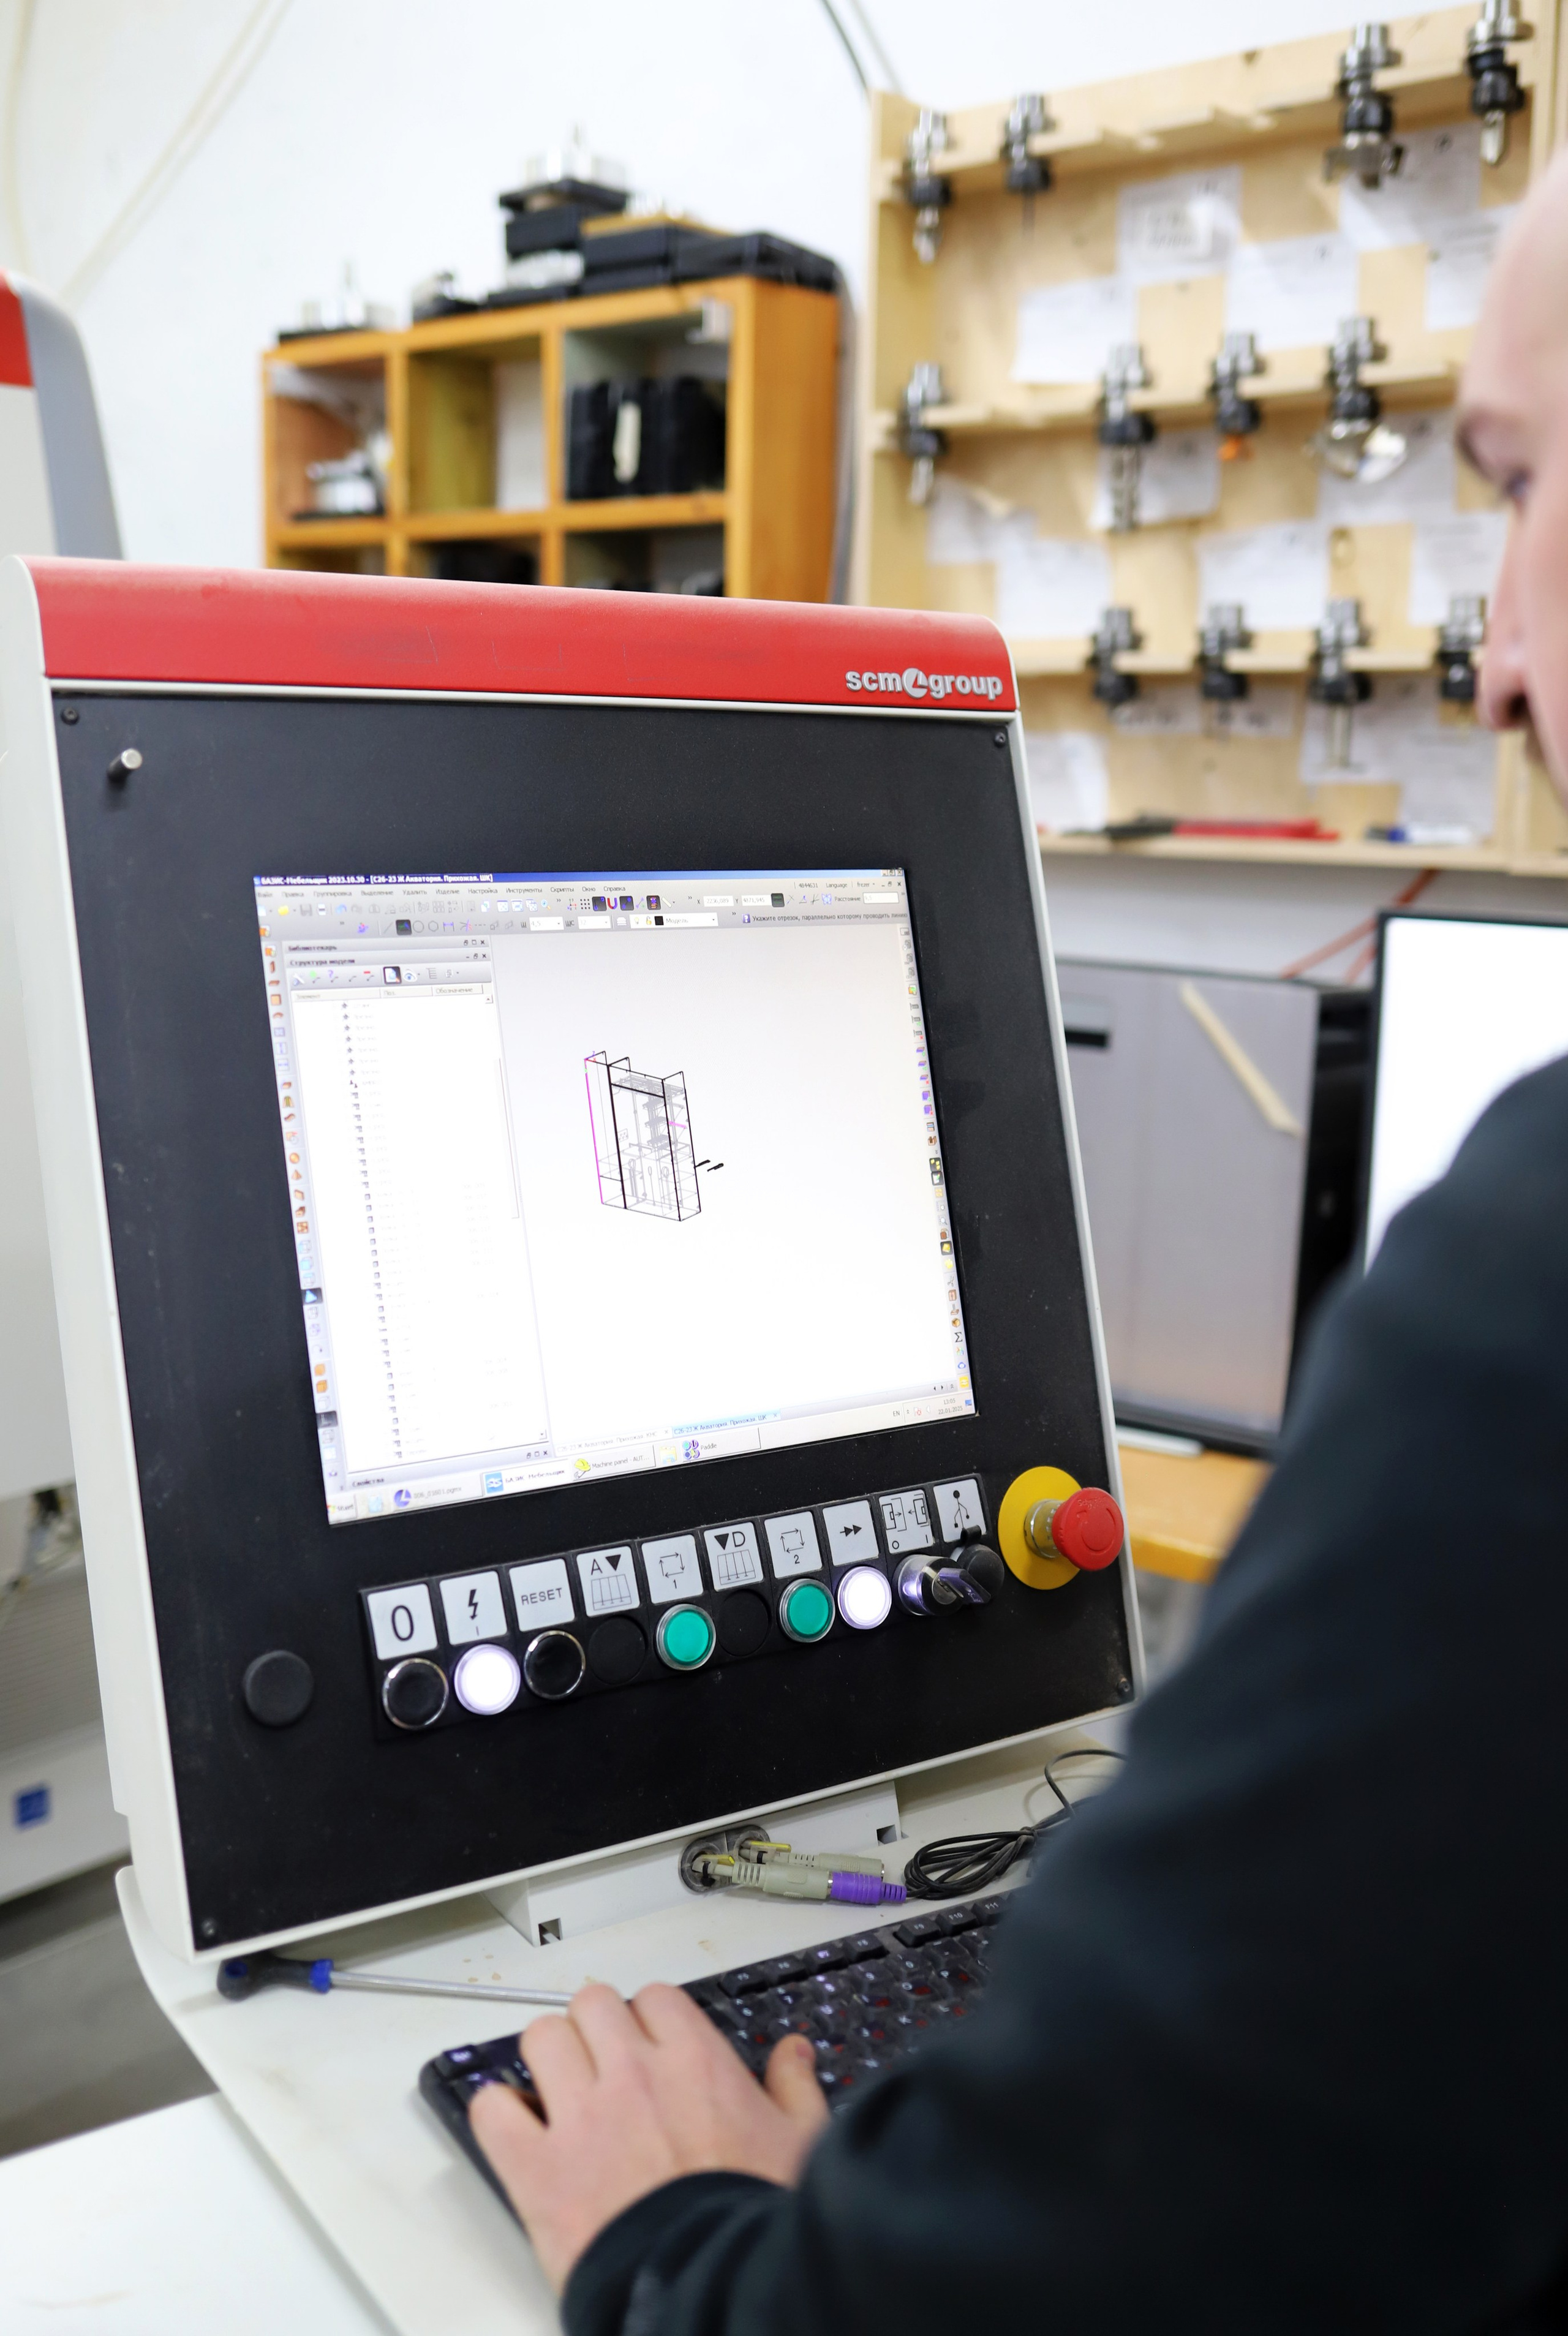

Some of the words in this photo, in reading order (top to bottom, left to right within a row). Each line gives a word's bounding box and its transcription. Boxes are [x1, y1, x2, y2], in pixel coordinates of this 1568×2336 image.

[845, 670, 903, 692] scm
[928, 674, 1003, 701] group
[938, 1406, 963, 1415] 22.01.2025
[592, 1460, 613, 1469] Machine
[733, 1531, 745, 1547] D
[794, 1554, 800, 1564] 2
[590, 1559, 603, 1575] A
[673, 1580, 678, 1589] 1
[521, 1587, 562, 1606] RESET
